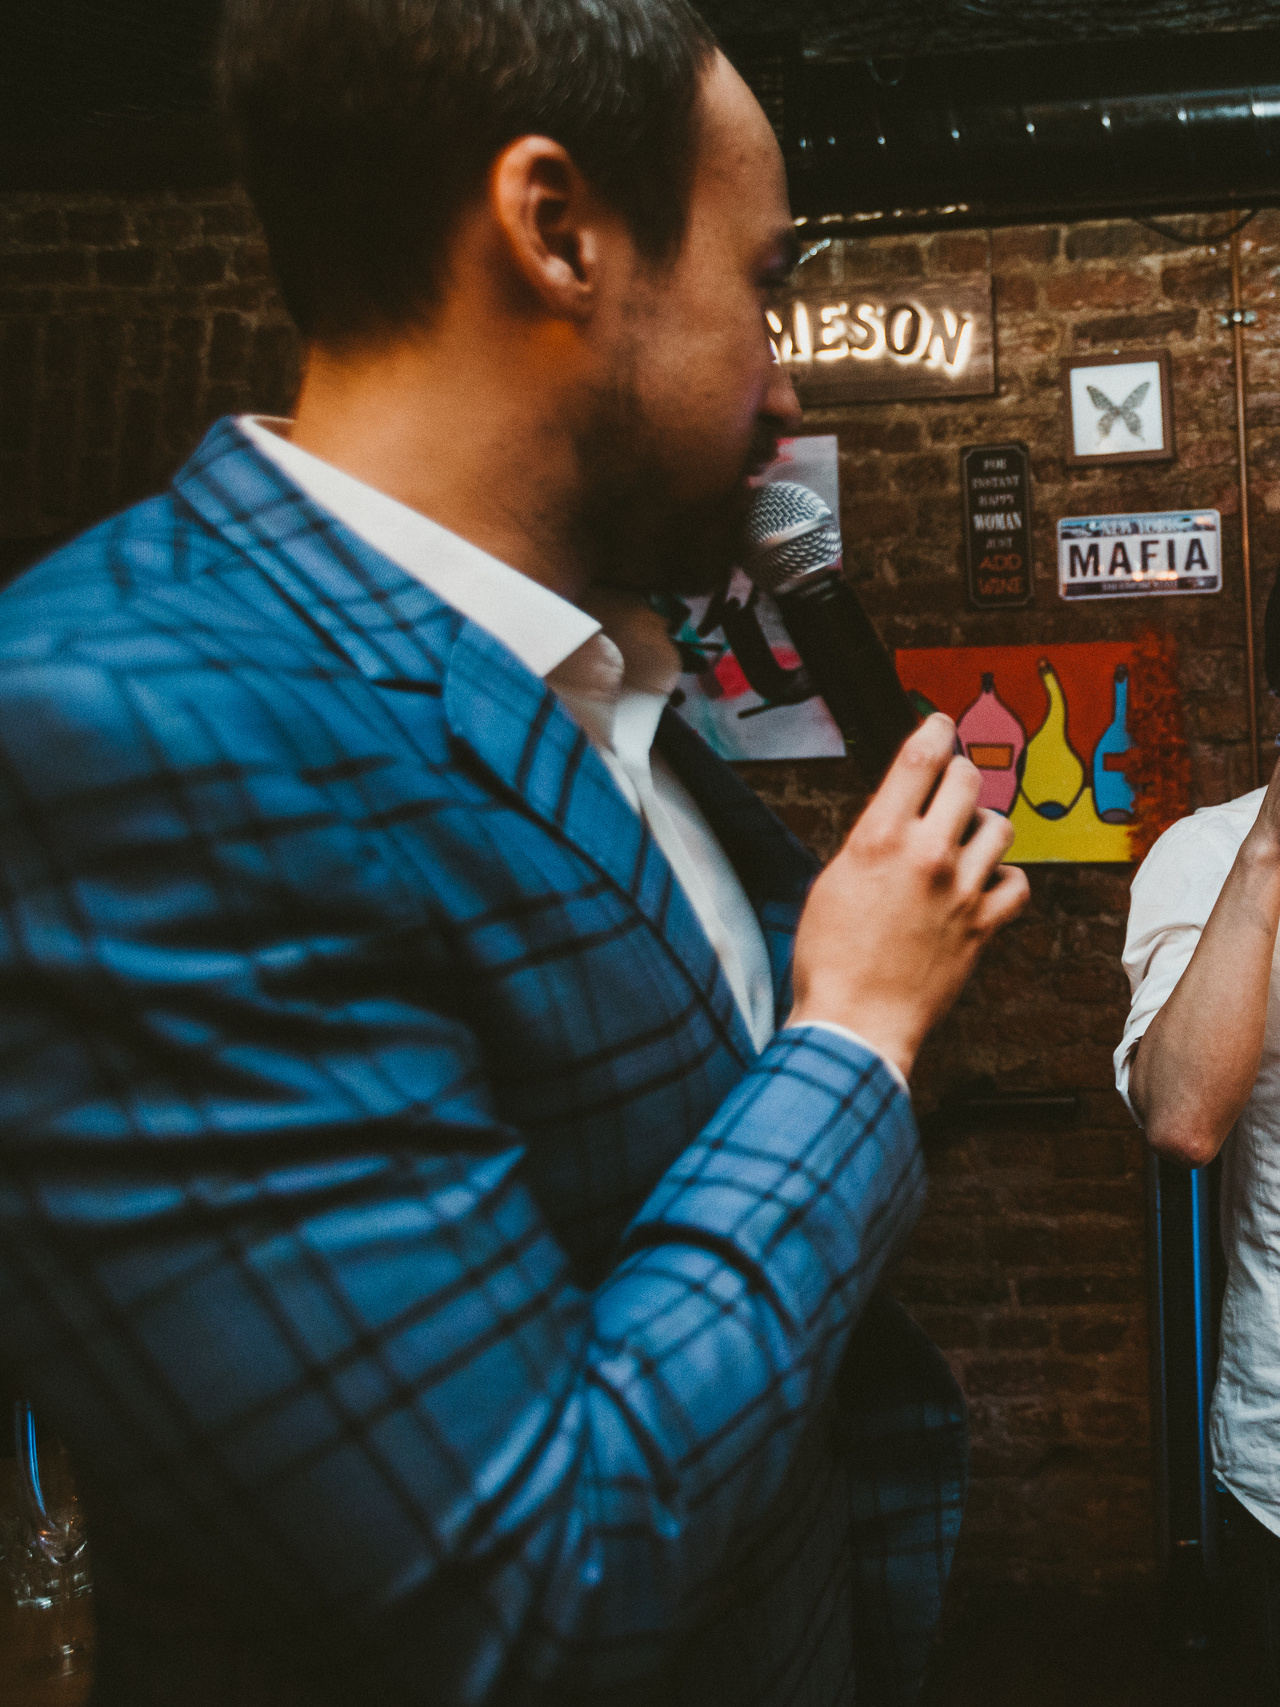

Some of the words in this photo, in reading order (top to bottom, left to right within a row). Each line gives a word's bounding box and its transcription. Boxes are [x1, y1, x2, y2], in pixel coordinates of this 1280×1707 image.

[983, 459, 1007, 470] FOR
[972, 474, 1020, 490] INSTANT
[977, 493, 1014, 507] HAPPY
[972, 511, 1022, 532] WOMAN
[978, 552, 1022, 572] ADD
[1069, 538, 1208, 578] MAFIA
[977, 576, 1024, 596] WINE
